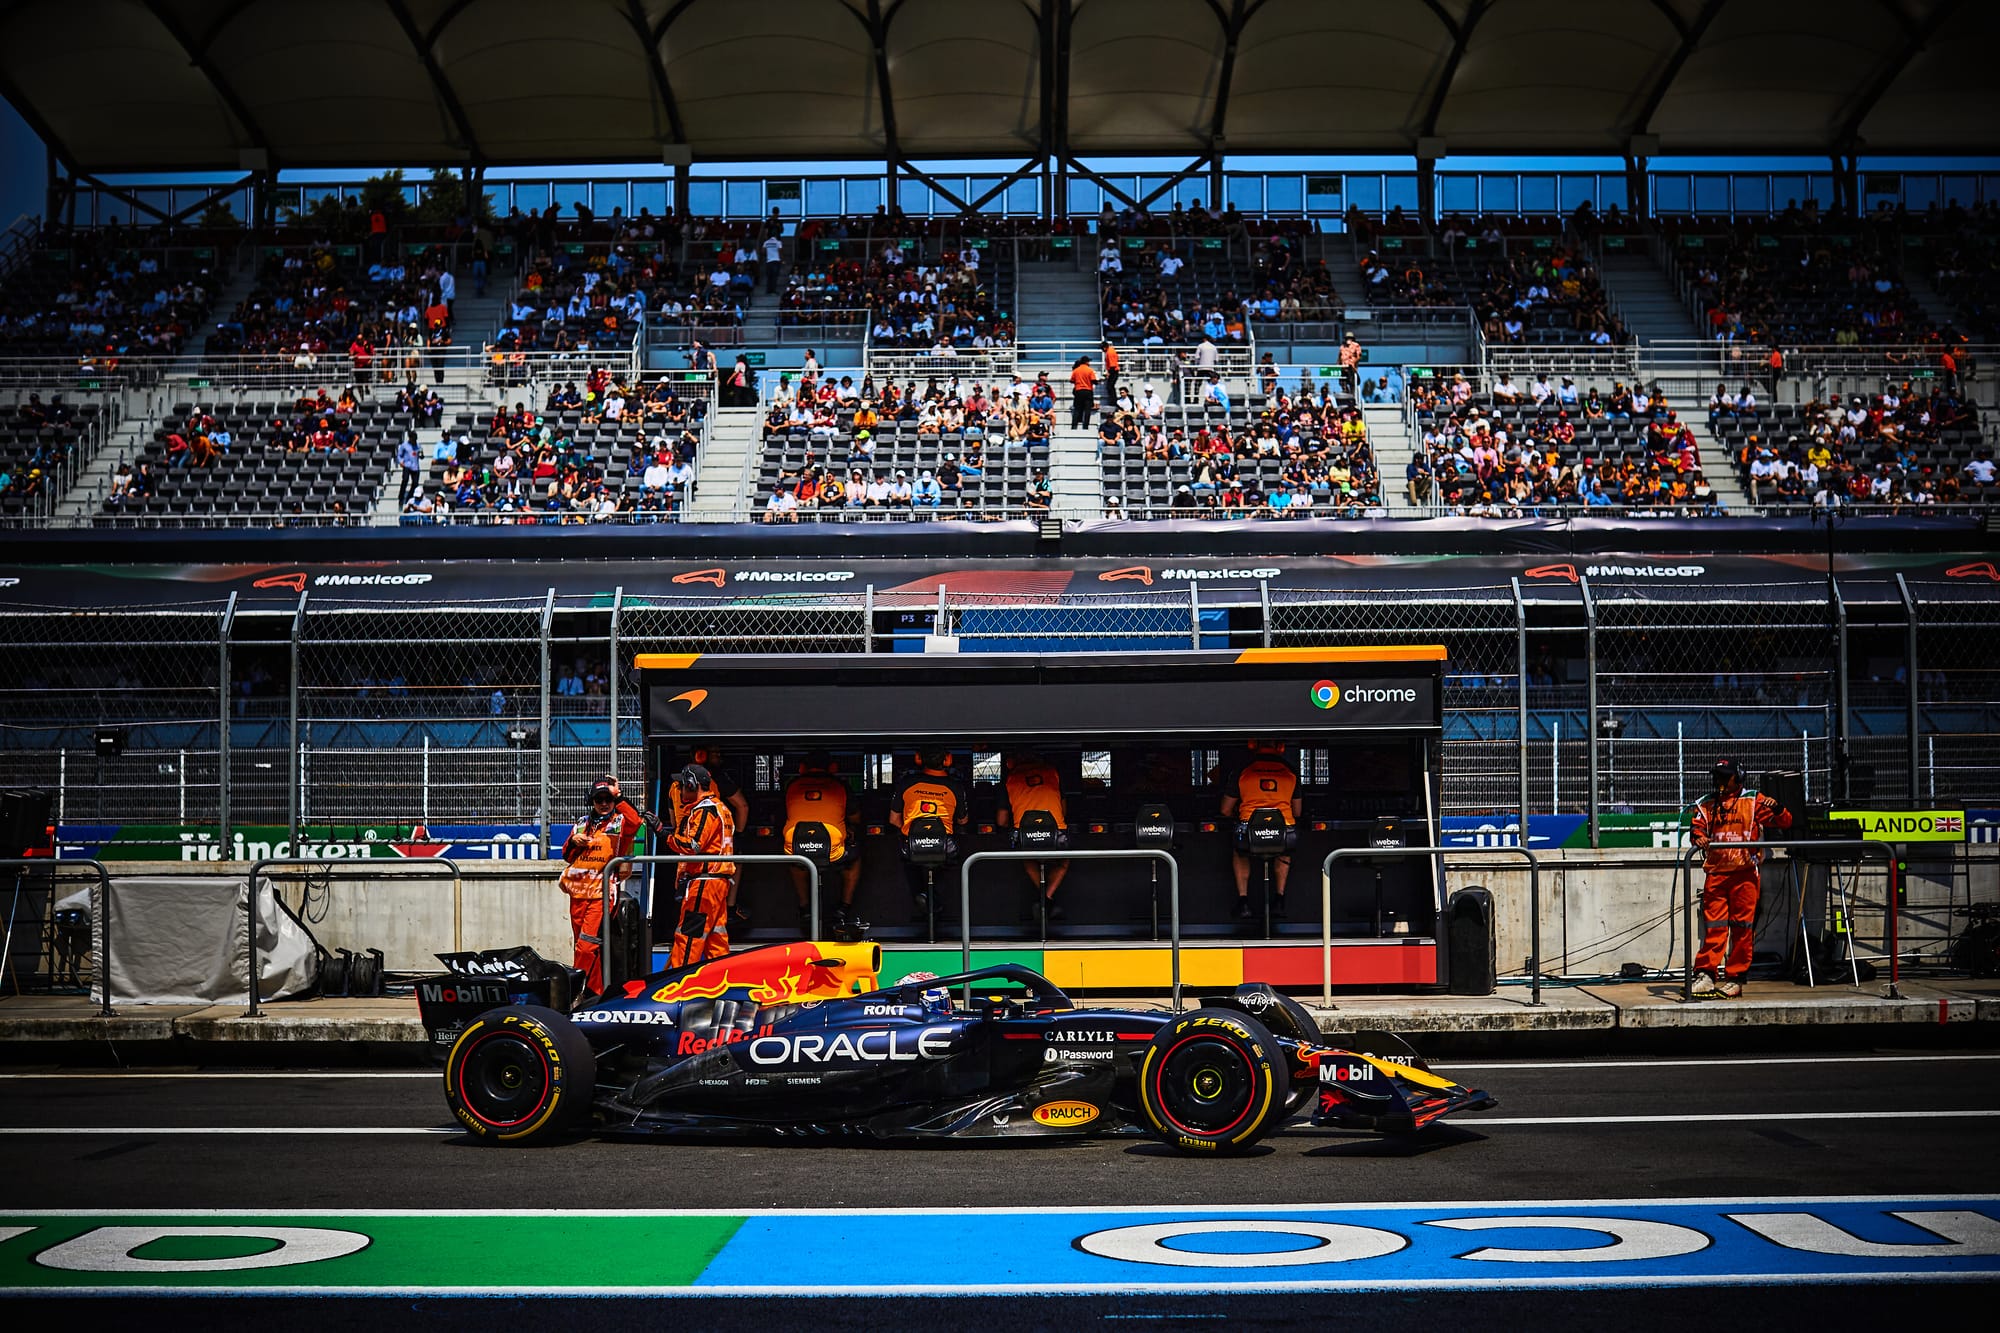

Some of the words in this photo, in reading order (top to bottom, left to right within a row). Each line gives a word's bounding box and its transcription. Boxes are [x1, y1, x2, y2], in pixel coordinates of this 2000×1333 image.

[734, 570, 855, 582] #MexicoGP
[1161, 568, 1281, 579] #MexicoGP
[1585, 565, 1705, 577] #MexicoGP
[314, 573, 433, 586] #MexicoGP
[901, 614, 915, 623] P3
[1344, 684, 1417, 703] chrome
[1142, 825, 1167, 833] webex
[1862, 817, 1933, 833] LANDO
[1026, 831, 1051, 839] webex
[1254, 828, 1280, 836] webex
[915, 837, 940, 845] webex
[1375, 838, 1400, 846] webex
[423, 983, 483, 1003] Mobil
[1238, 994, 1260, 1006] Hard
[864, 1004, 907, 1016] ROKT
[570, 1010, 674, 1025] HONDA
[1175, 1020, 1189, 1035] P
[1192, 1017, 1250, 1039] ZERO
[503, 1016, 518, 1024] P
[519, 1020, 561, 1063] ZERO
[677, 1029, 728, 1056] Red
[1044, 1031, 1115, 1043] CARLYLE
[748, 1027, 953, 1065] ORACLE
[1058, 1049, 1114, 1062] 1Password
[1381, 1055, 1416, 1068] AT&T
[1319, 1064, 1374, 1082] Mobil
[704, 1078, 730, 1087] HEXAGON
[786, 1077, 822, 1086] SIEMENS
[1050, 1107, 1092, 1121] RAUCH
